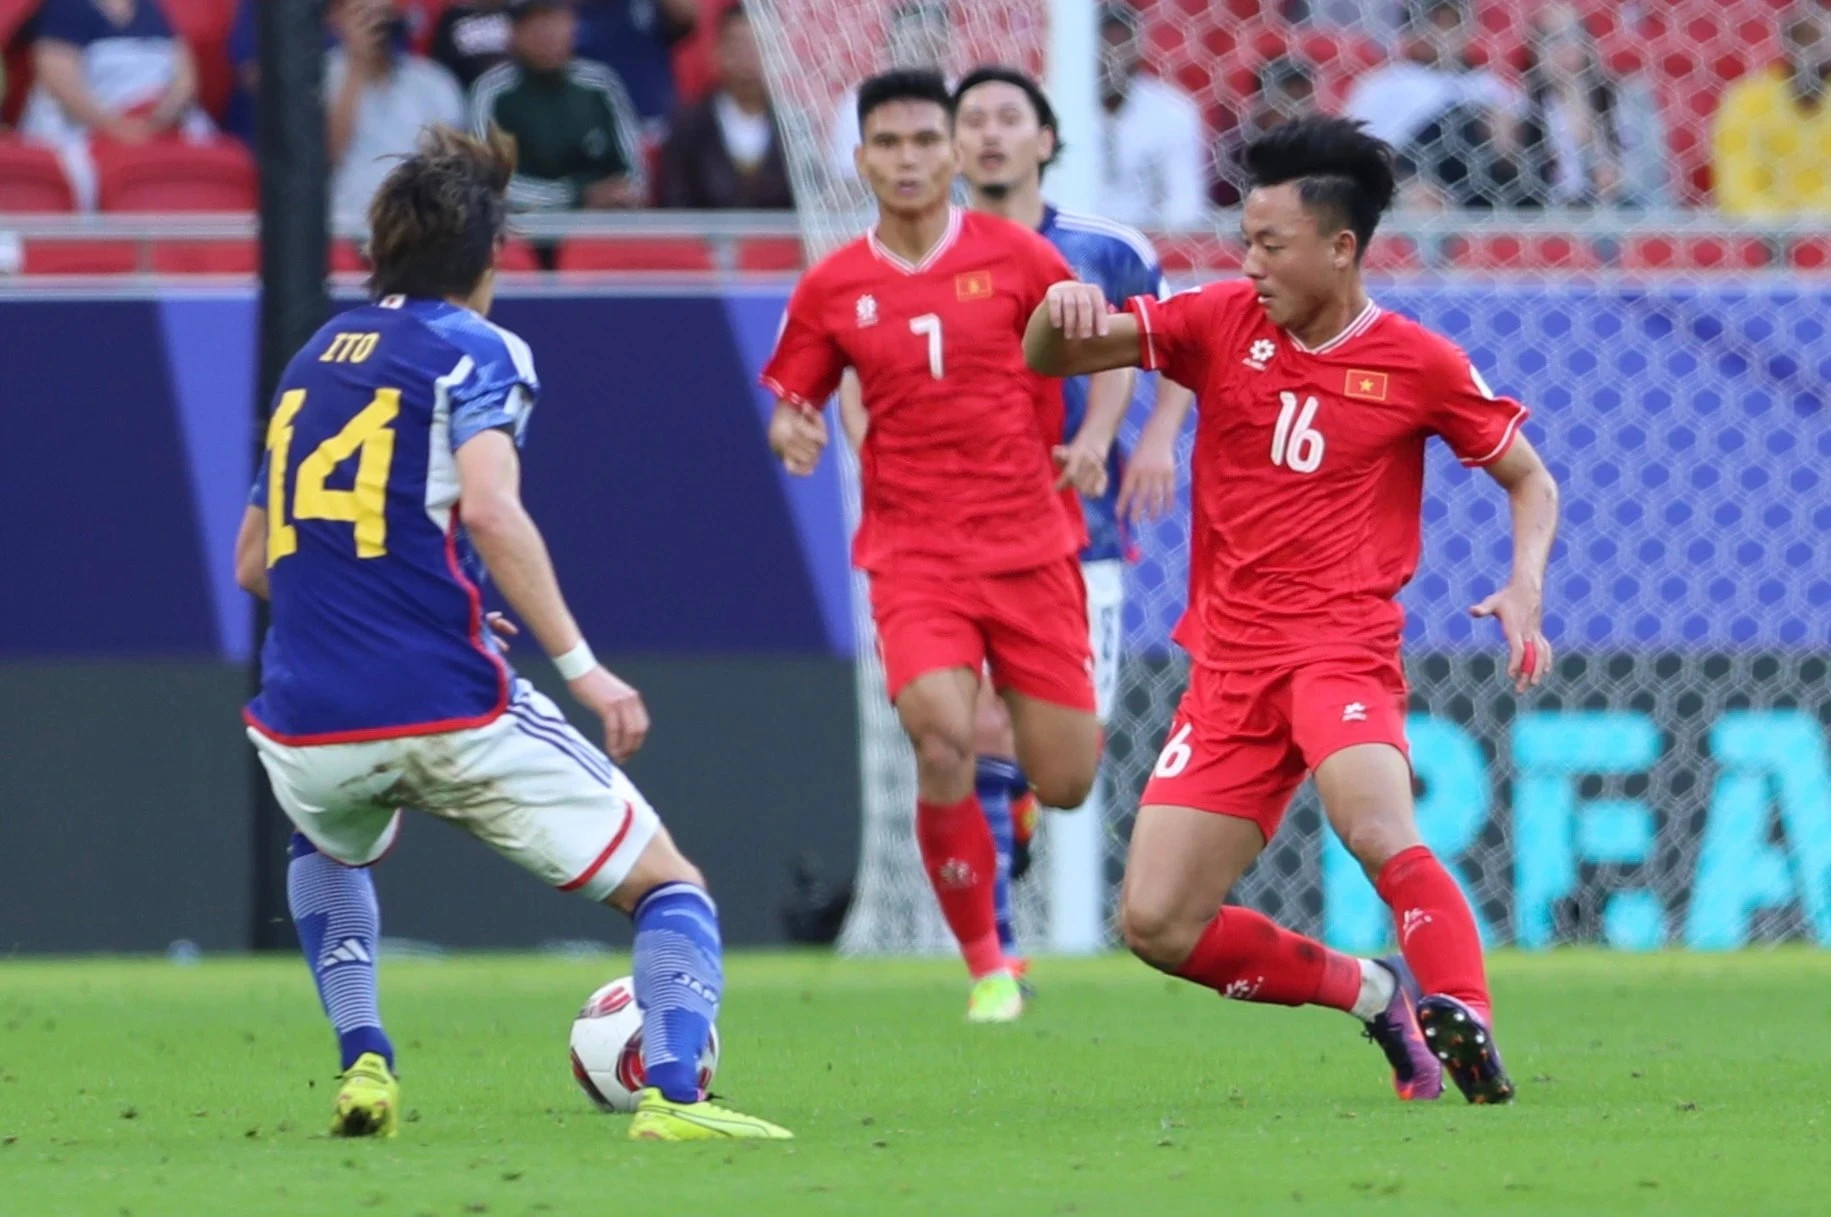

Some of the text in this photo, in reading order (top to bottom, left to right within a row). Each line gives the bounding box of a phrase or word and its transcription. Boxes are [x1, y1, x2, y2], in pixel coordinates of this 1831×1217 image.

[319, 332, 381, 363] ITO
[908, 312, 945, 380] 7
[1270, 390, 1325, 473] 16
[266, 387, 402, 568] 14
[1152, 721, 1193, 778] 6
